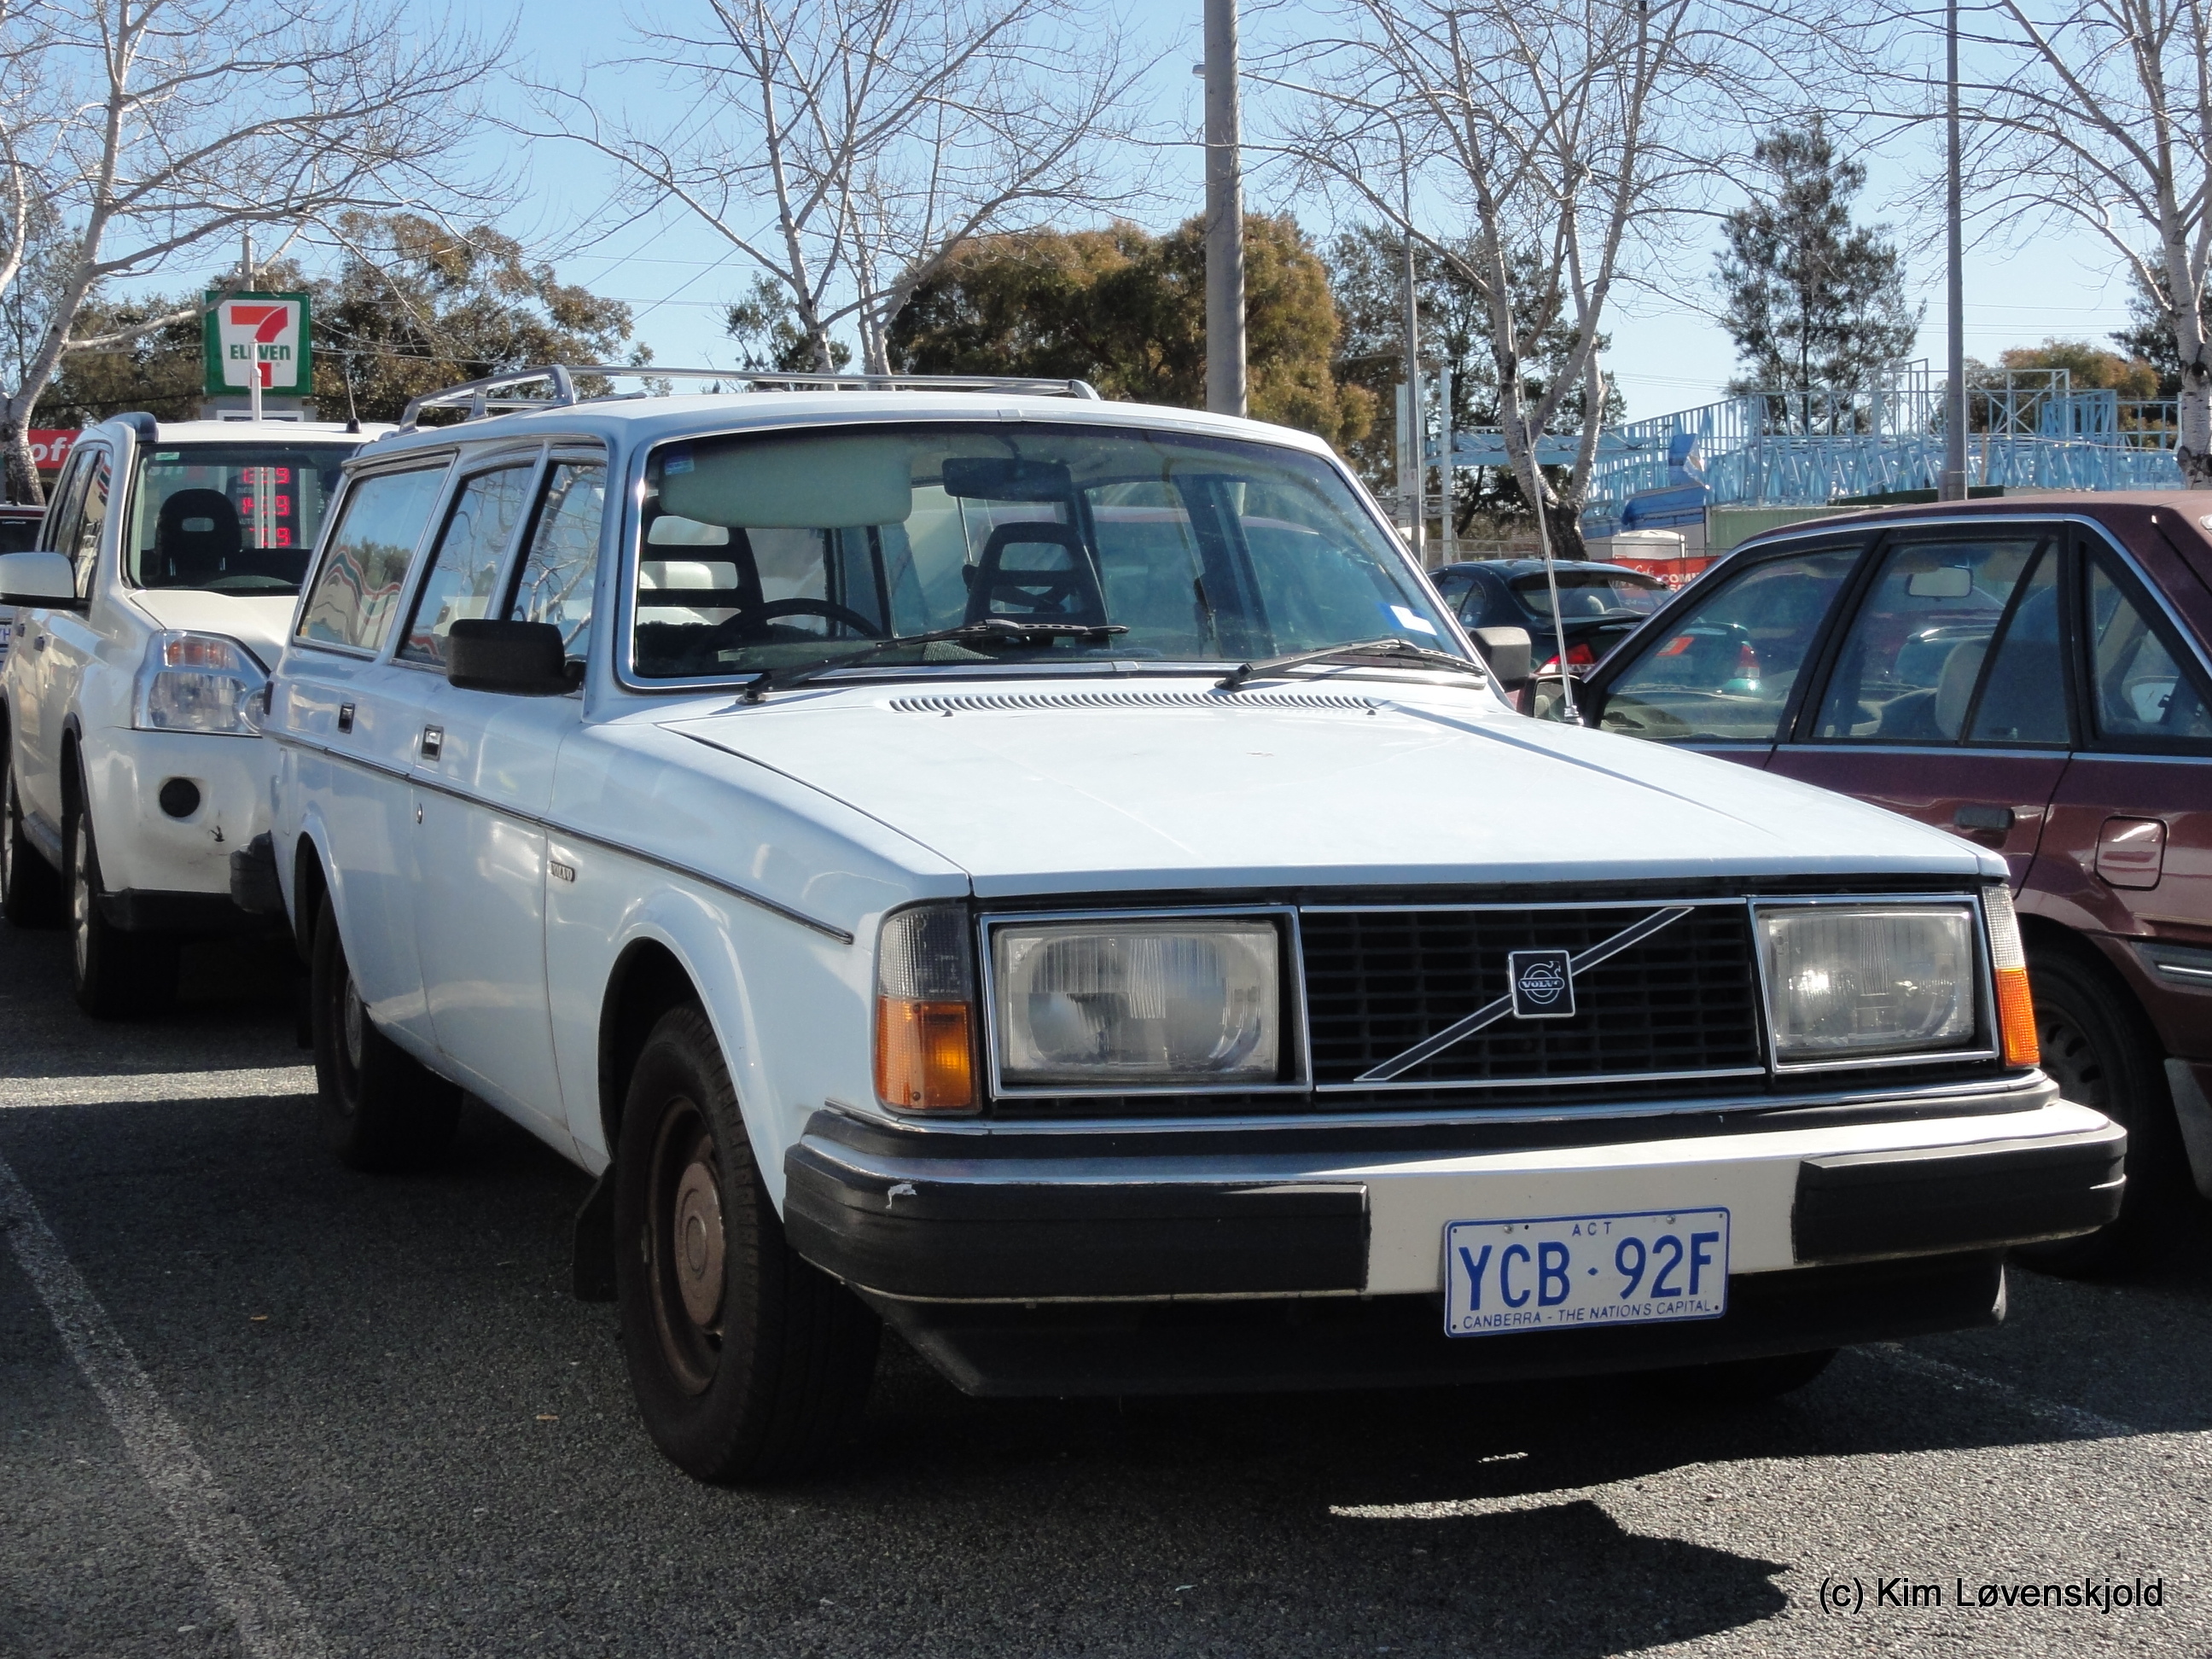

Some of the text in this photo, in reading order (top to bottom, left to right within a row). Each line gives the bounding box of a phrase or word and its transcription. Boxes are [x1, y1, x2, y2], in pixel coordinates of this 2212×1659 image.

[230, 306, 288, 387] 7
[1572, 1221, 1612, 1237] ACT
[1463, 1312, 1541, 1330] CANBERRA
[1558, 1307, 1586, 1321] THE
[1656, 1299, 1712, 1315] CAPITAL
